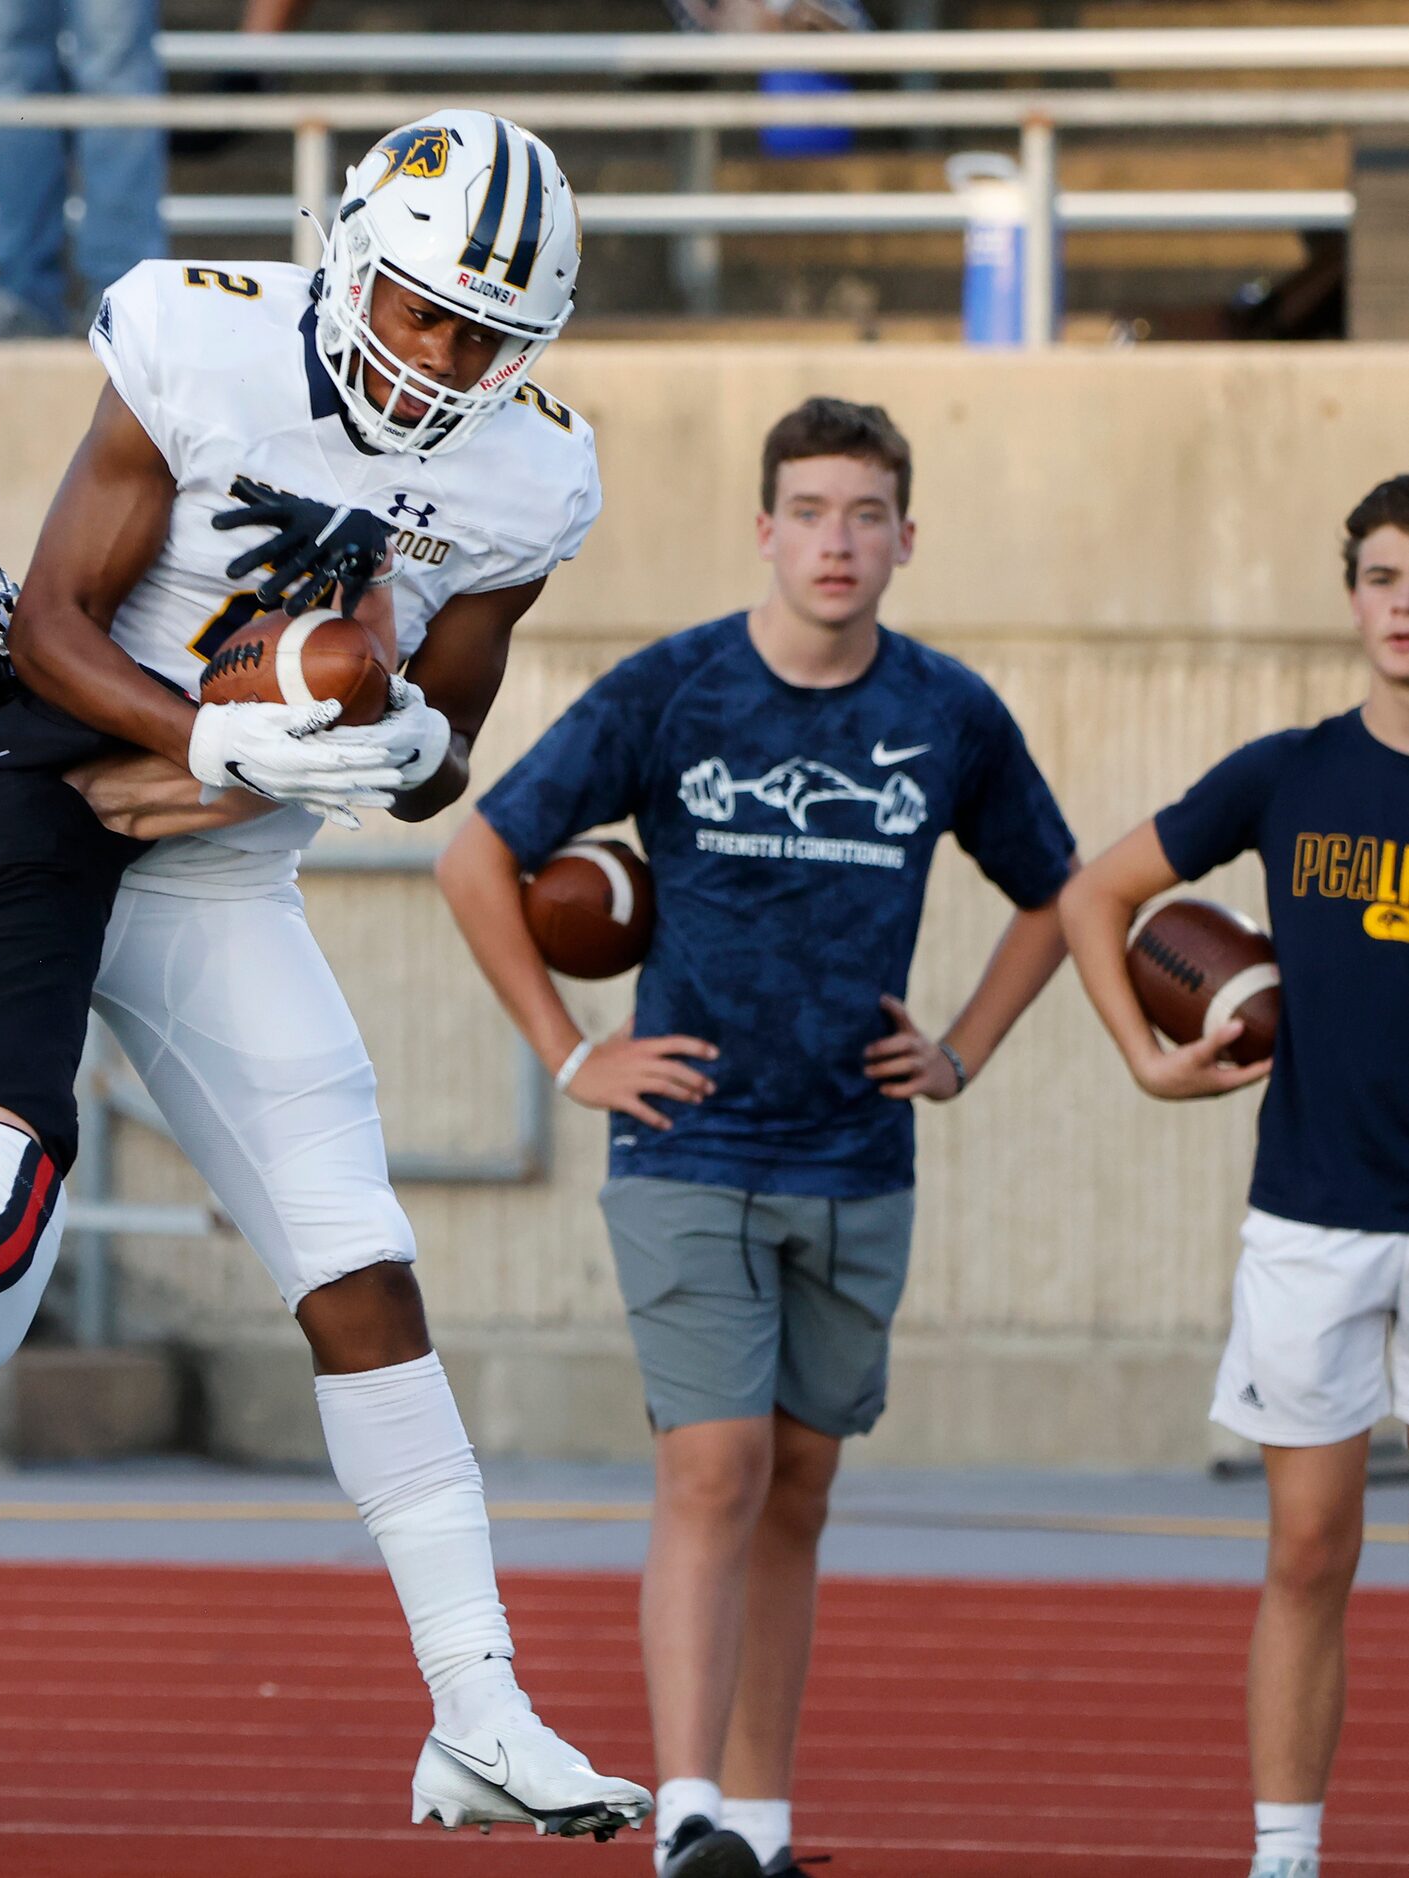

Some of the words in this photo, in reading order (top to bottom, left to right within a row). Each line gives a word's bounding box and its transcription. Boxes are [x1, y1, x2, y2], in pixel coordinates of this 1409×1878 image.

[182, 266, 263, 301] 2
[478, 354, 527, 391] Riddell
[512, 382, 573, 434] 2
[695, 828, 782, 858] STRENGTH
[795, 835, 906, 870] CONDITIONING
